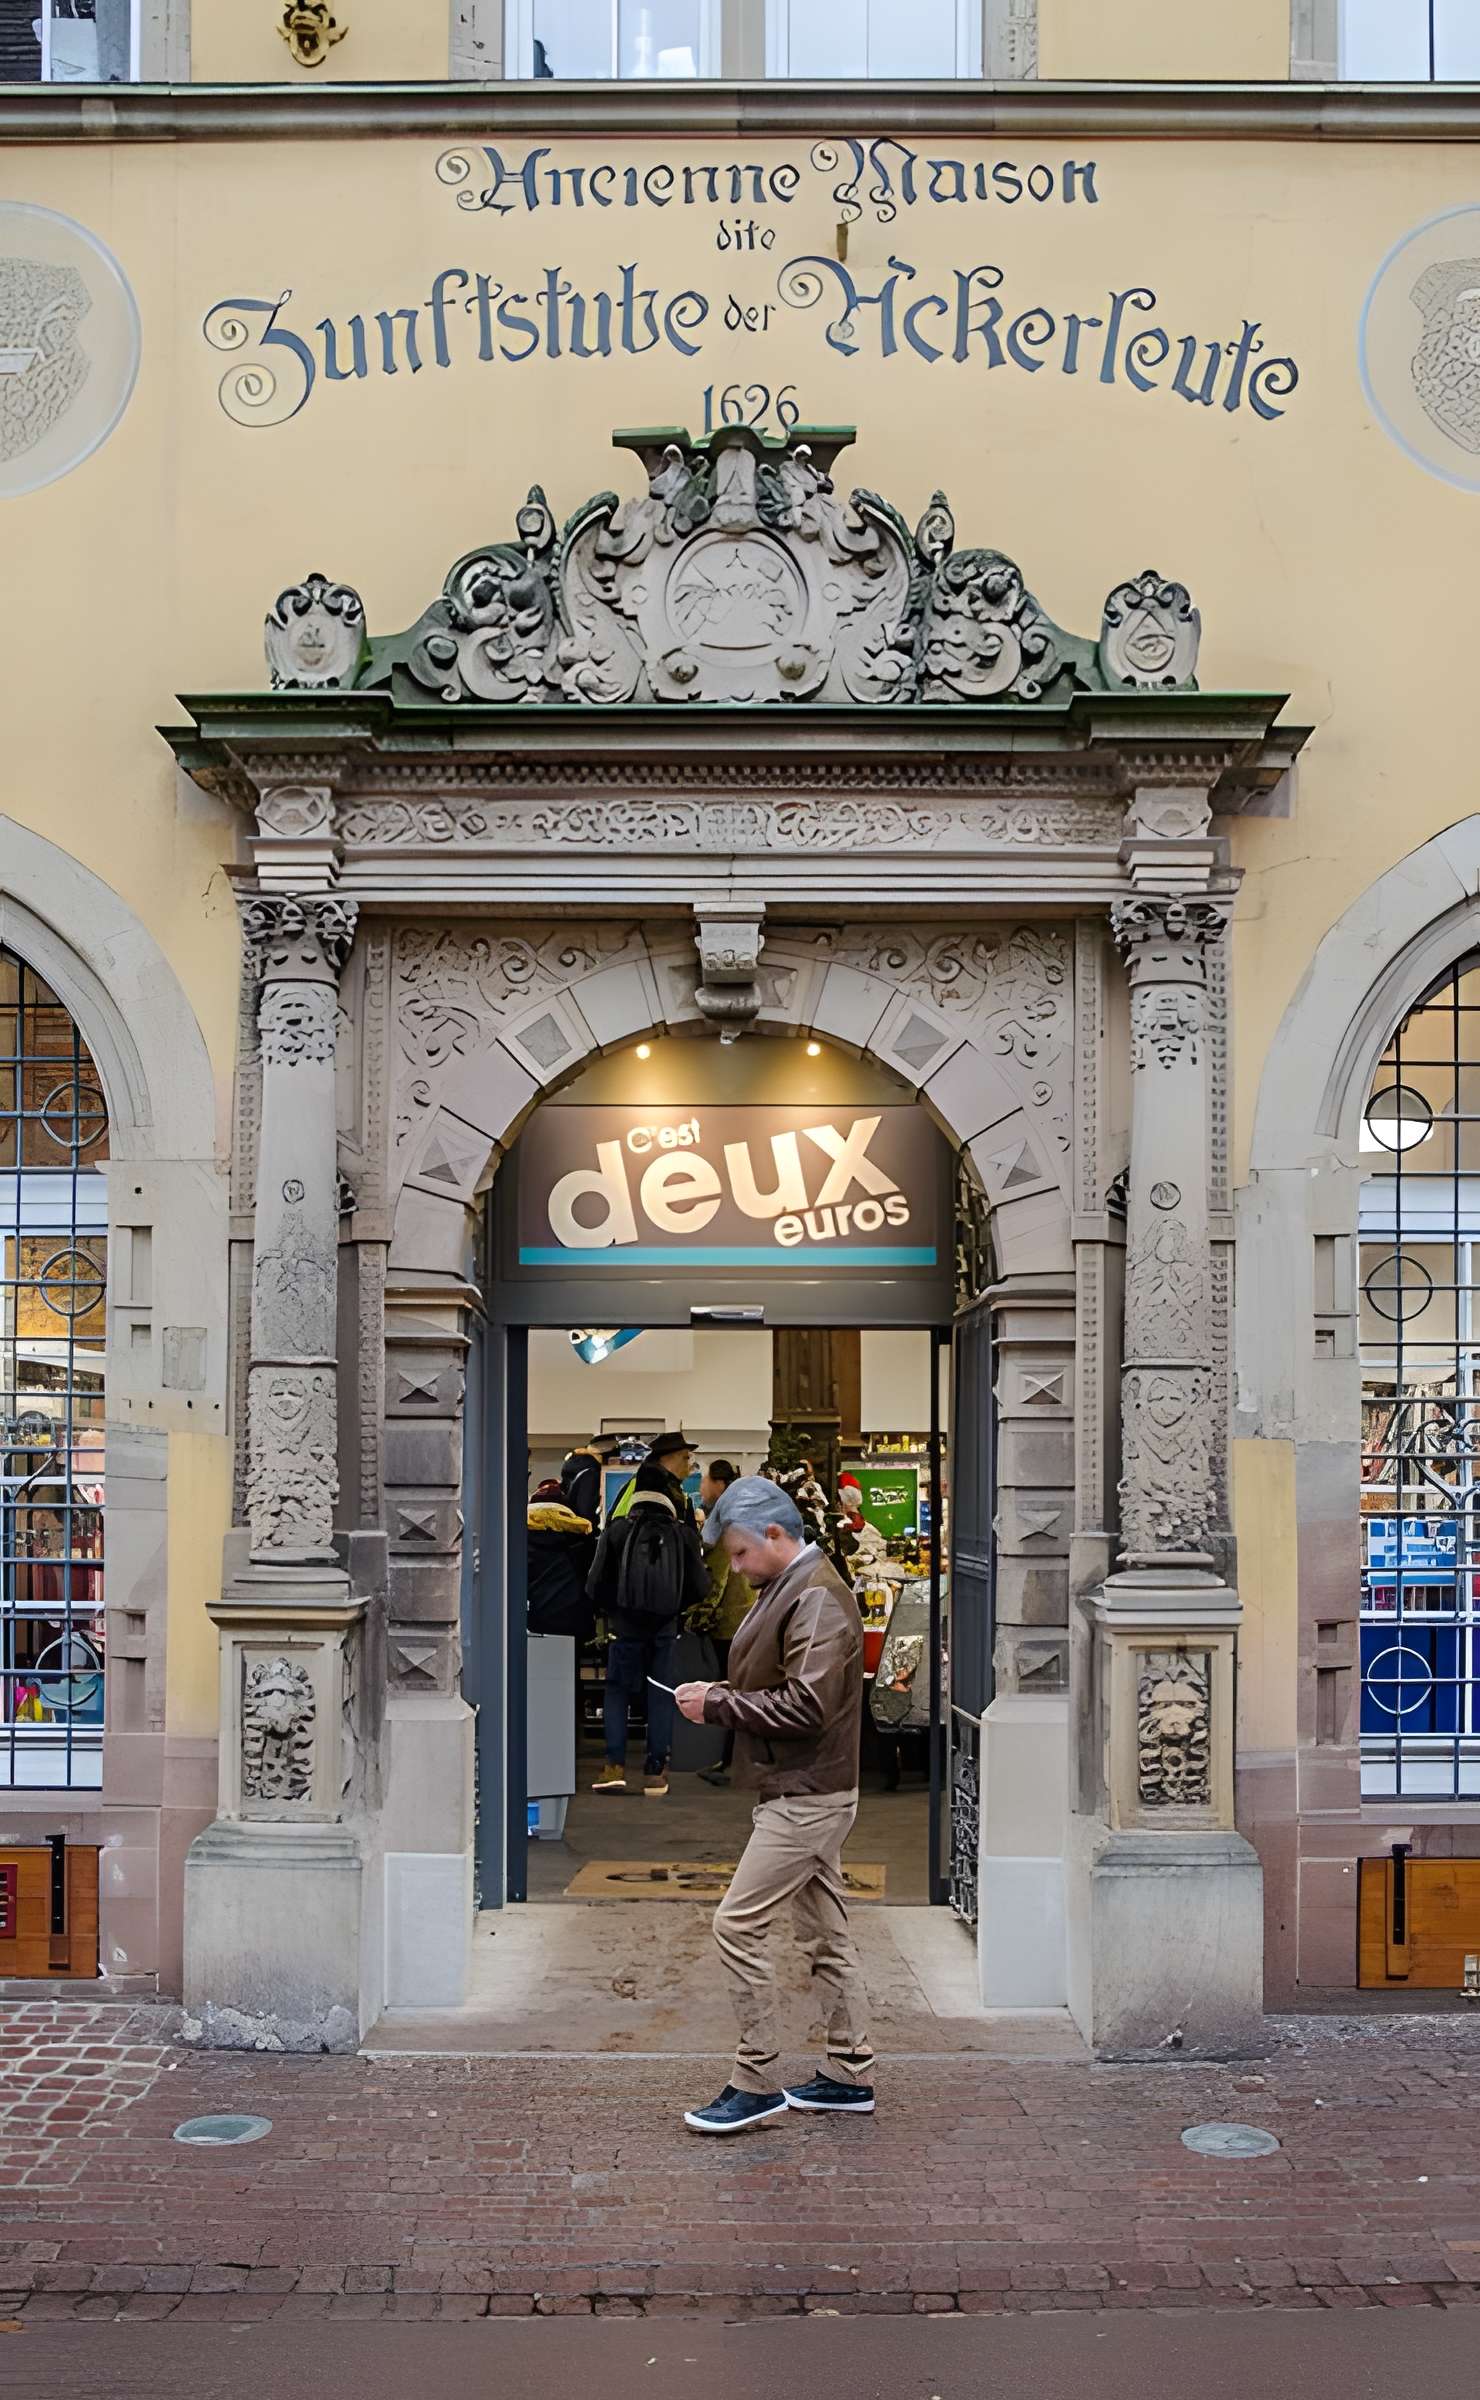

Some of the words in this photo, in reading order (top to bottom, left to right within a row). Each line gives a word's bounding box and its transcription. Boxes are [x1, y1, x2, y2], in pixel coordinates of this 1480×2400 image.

[436, 146, 799, 214] Ancienne
[811, 138, 1099, 222] Maison
[203, 263, 709, 428] Zunftstube
[724, 294, 776, 331] der
[777, 255, 1299, 420] Ackerleute
[703, 384, 800, 434] 1626
[627, 1117, 701, 1153] C'est
[548, 1115, 900, 1248] deux
[774, 1194, 910, 1247] euros
